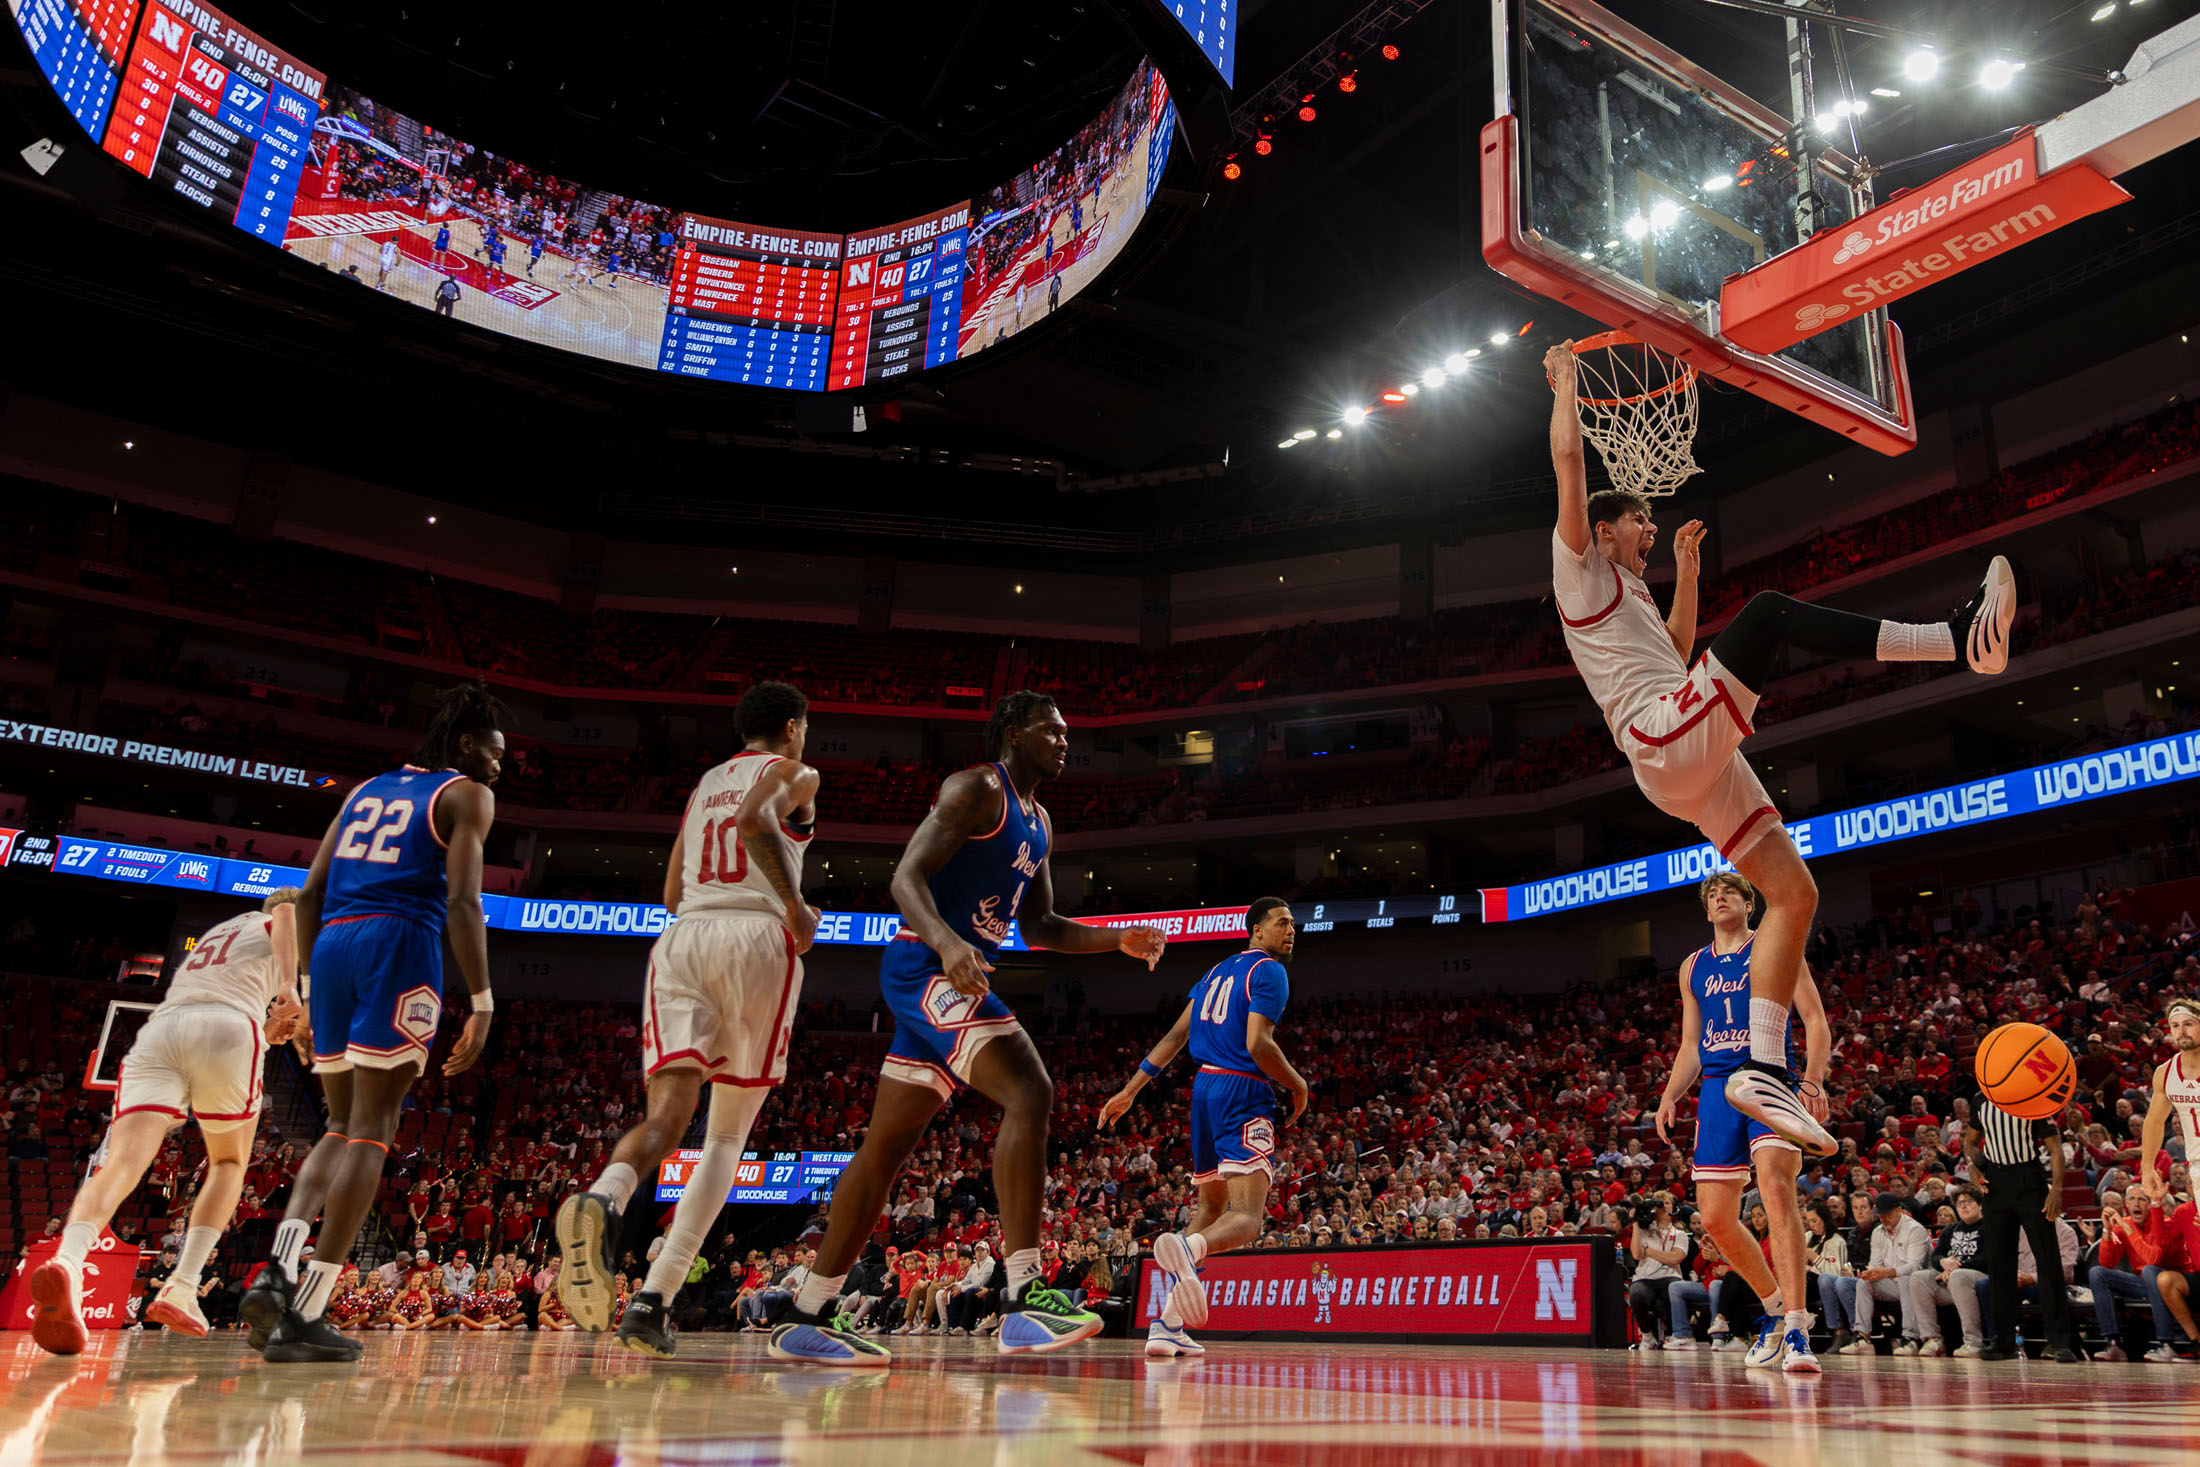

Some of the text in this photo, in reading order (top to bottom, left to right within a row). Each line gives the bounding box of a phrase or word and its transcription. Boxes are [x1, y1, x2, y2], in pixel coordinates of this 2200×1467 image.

[149, 10, 184, 53] N
[157, 0, 322, 100] MPIRE-FENCE.COM
[200, 40, 268, 87] 2ND 16:04
[175, 81, 203, 104] FOULS:
[191, 58, 264, 111] 40 27
[279, 95, 308, 121] UWG
[142, 78, 288, 170] 30 REBOUNDS 25
[276, 126, 299, 142] POSS
[140, 97, 280, 185] 8 ASSISTS 4
[261, 133, 290, 155] FOULS:
[134, 115, 276, 201] 6 TURNOVERS 8
[130, 131, 271, 218] 4 STEALS 5
[124, 149, 266, 234] 0 BLOCKS 3
[683, 220, 840, 258] EMPIRE-FENCE.COM
[847, 208, 968, 258] EMPIRE-FENCE.COM
[884, 242, 933, 264] 2ND 16:04
[942, 238, 961, 255] UWG
[697, 266, 734, 279] HOIBERG
[699, 254, 740, 269] ESSEGIAN
[880, 258, 931, 288] 40 27
[942, 264, 958, 276] POSS
[847, 261, 872, 287] N
[674, 295, 717, 309] 51 MAST
[676, 285, 739, 302] 10 LAWRENCE
[848, 290, 953, 326] 30 REBOUNDS 25
[689, 320, 733, 334] HARDEWIG
[849, 306, 949, 340] 8 ASSISTS 4
[667, 339, 713, 354] 10 SMITH
[847, 321, 948, 355] 6 TURNOVERS 8
[666, 350, 717, 366] 11 GRIFFIN
[846, 337, 947, 370] 4 STEALS 5
[662, 361, 709, 376] 22 CHIME
[843, 352, 945, 386] 0 BLOCKS 3
[0, 719, 310, 788] EXTERIOR PREMIUM LEVEL
[2034, 734, 2200, 805] WOODHOU
[1835, 779, 2009, 847] WOODHOUSE
[334, 796, 414, 864] 22
[24, 837, 50, 850] 2ND
[697, 816, 748, 884] 10
[12, 849, 54, 866] 16:04
[61, 846, 98, 868] 27
[107, 848, 168, 864] 2 TIMEOUTS
[104, 865, 148, 879] 2 FOULS
[180, 860, 208, 878] UWG
[247, 868, 272, 883] 25
[1524, 860, 1648, 914] WOODHOUSE
[1314, 904, 1325, 920] 2
[1377, 900, 1385, 915] 1
[1439, 895, 1455, 911] 10
[1186, 911, 1248, 934] LAWRENC
[1303, 920, 1334, 933] ASSISTS
[1367, 916, 1394, 929] STEALS
[1432, 912, 1461, 925] POINTS
[186, 929, 241, 970] 51
[1705, 972, 1749, 998] West
[1200, 975, 1234, 1025] 10
[1723, 997, 1734, 1024] 1
[1702, 1019, 1750, 1050] Georg
[2023, 1050, 2059, 1084] N
[2169, 1094, 2200, 1105] NEBRAS
[679, 1150, 704, 1160] NEBRA
[742, 1152, 797, 1162] 2ND 16:04
[832, 1155, 853, 1163] GEOR
[663, 1164, 682, 1182] N
[737, 1165, 760, 1182] 40
[772, 1166, 794, 1182] 27
[736, 1189, 788, 1200] WOODHOUSE
[1339, 1273, 1500, 1308] BASKETBALL
[1535, 1258, 1577, 1320] N
